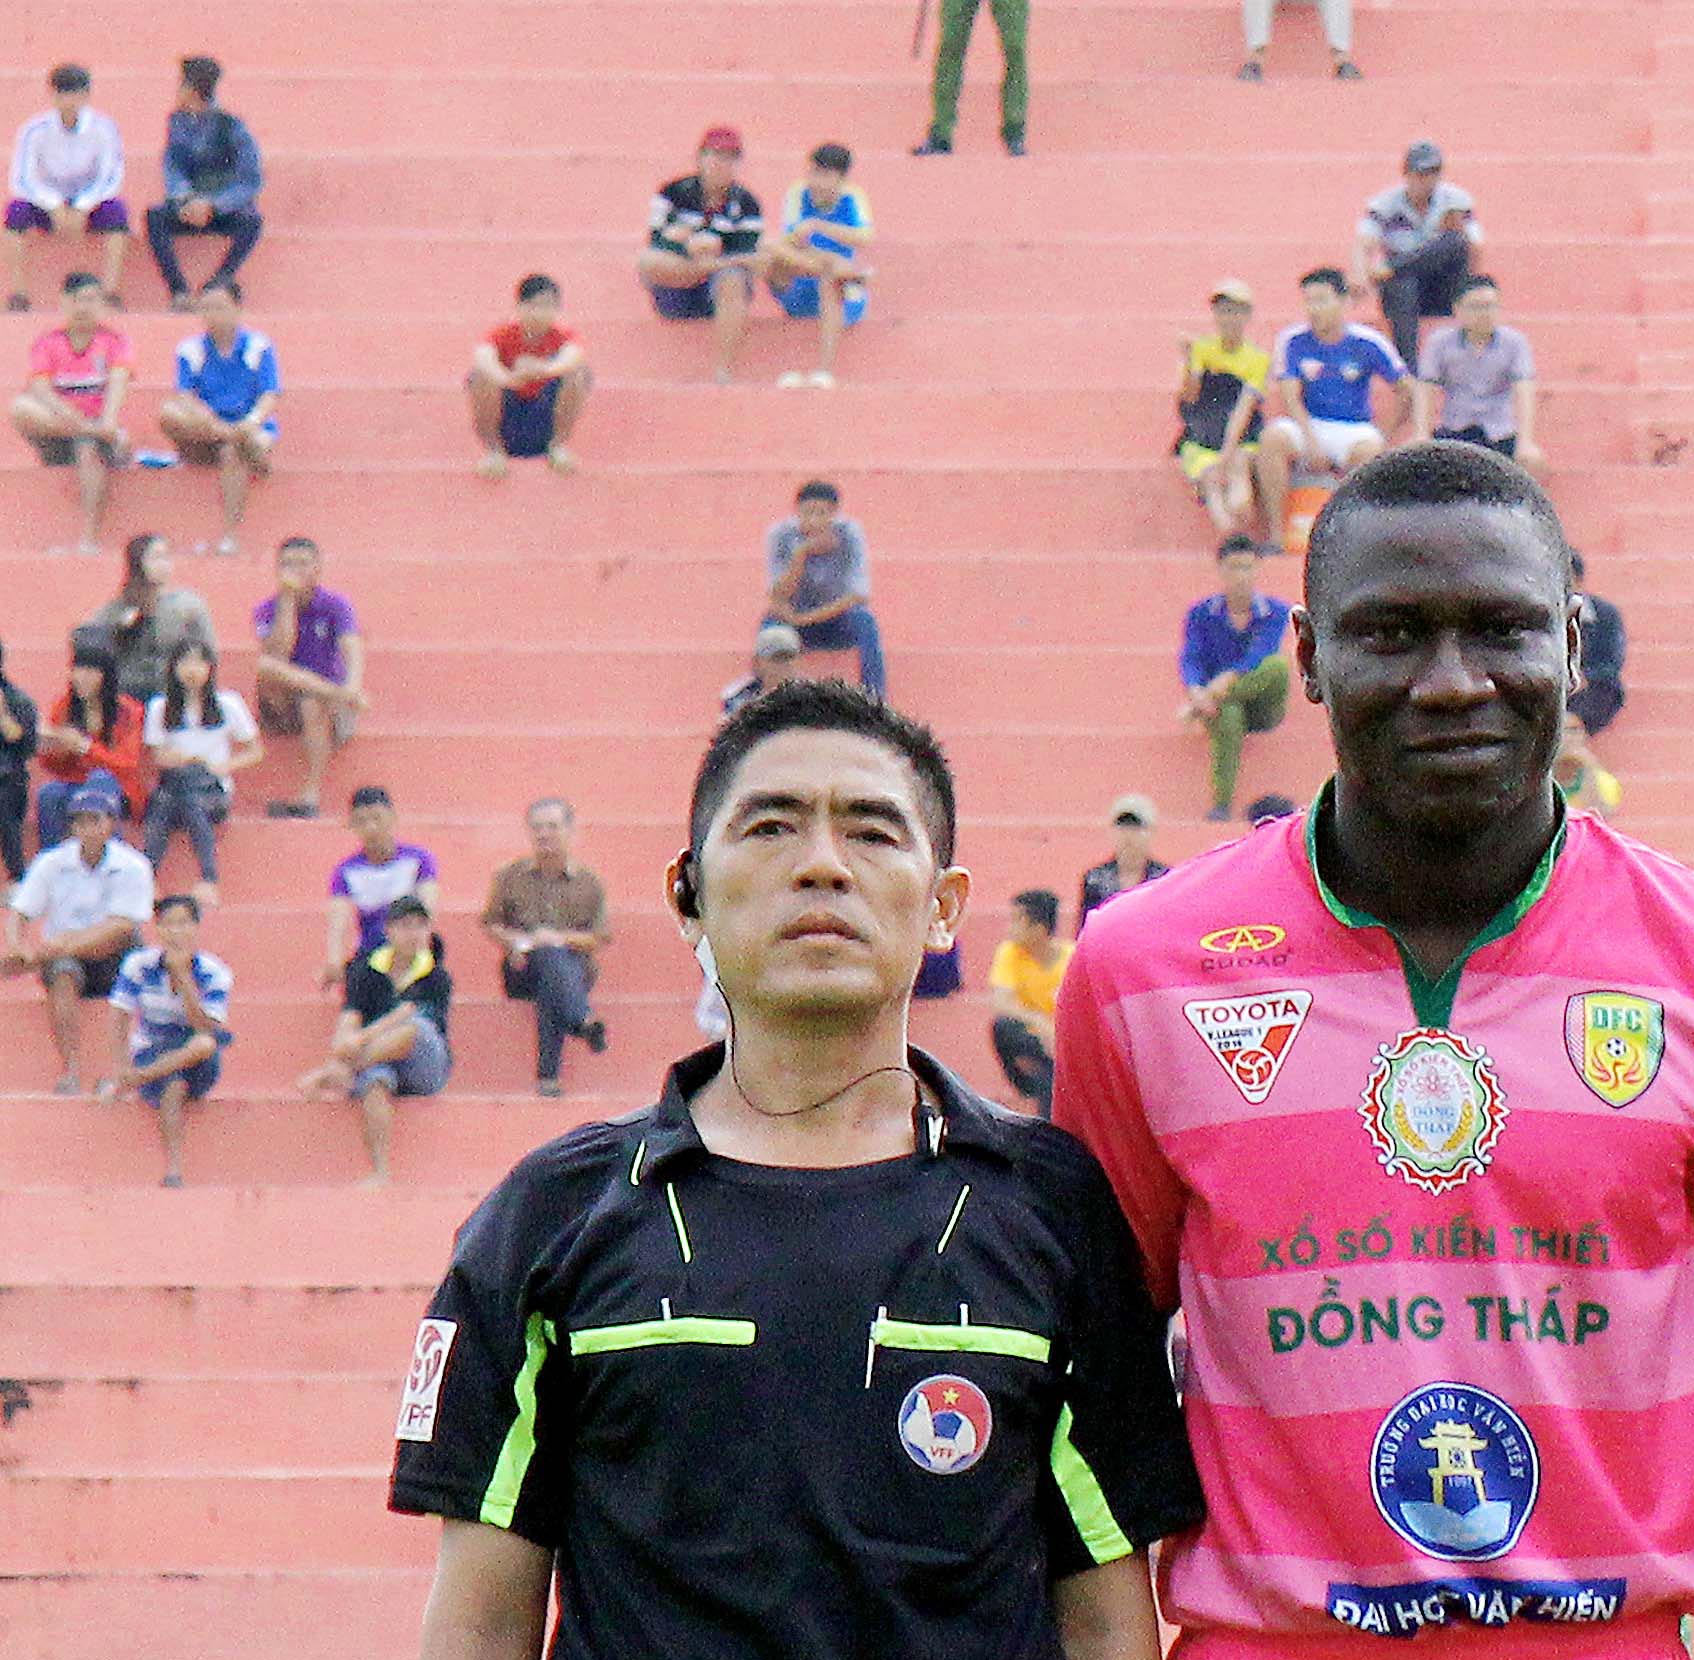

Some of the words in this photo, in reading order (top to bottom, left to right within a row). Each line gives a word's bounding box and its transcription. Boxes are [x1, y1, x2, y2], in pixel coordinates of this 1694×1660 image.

[1195, 998, 1299, 1024] TOYOTA
[1593, 1007, 1642, 1032] DFC
[1336, 1211, 1394, 1262] SỐ
[1410, 1211, 1497, 1258] KIẾN
[1267, 1274, 1445, 1354] ĐỒNG
[1466, 1283, 1610, 1345] THÁP
